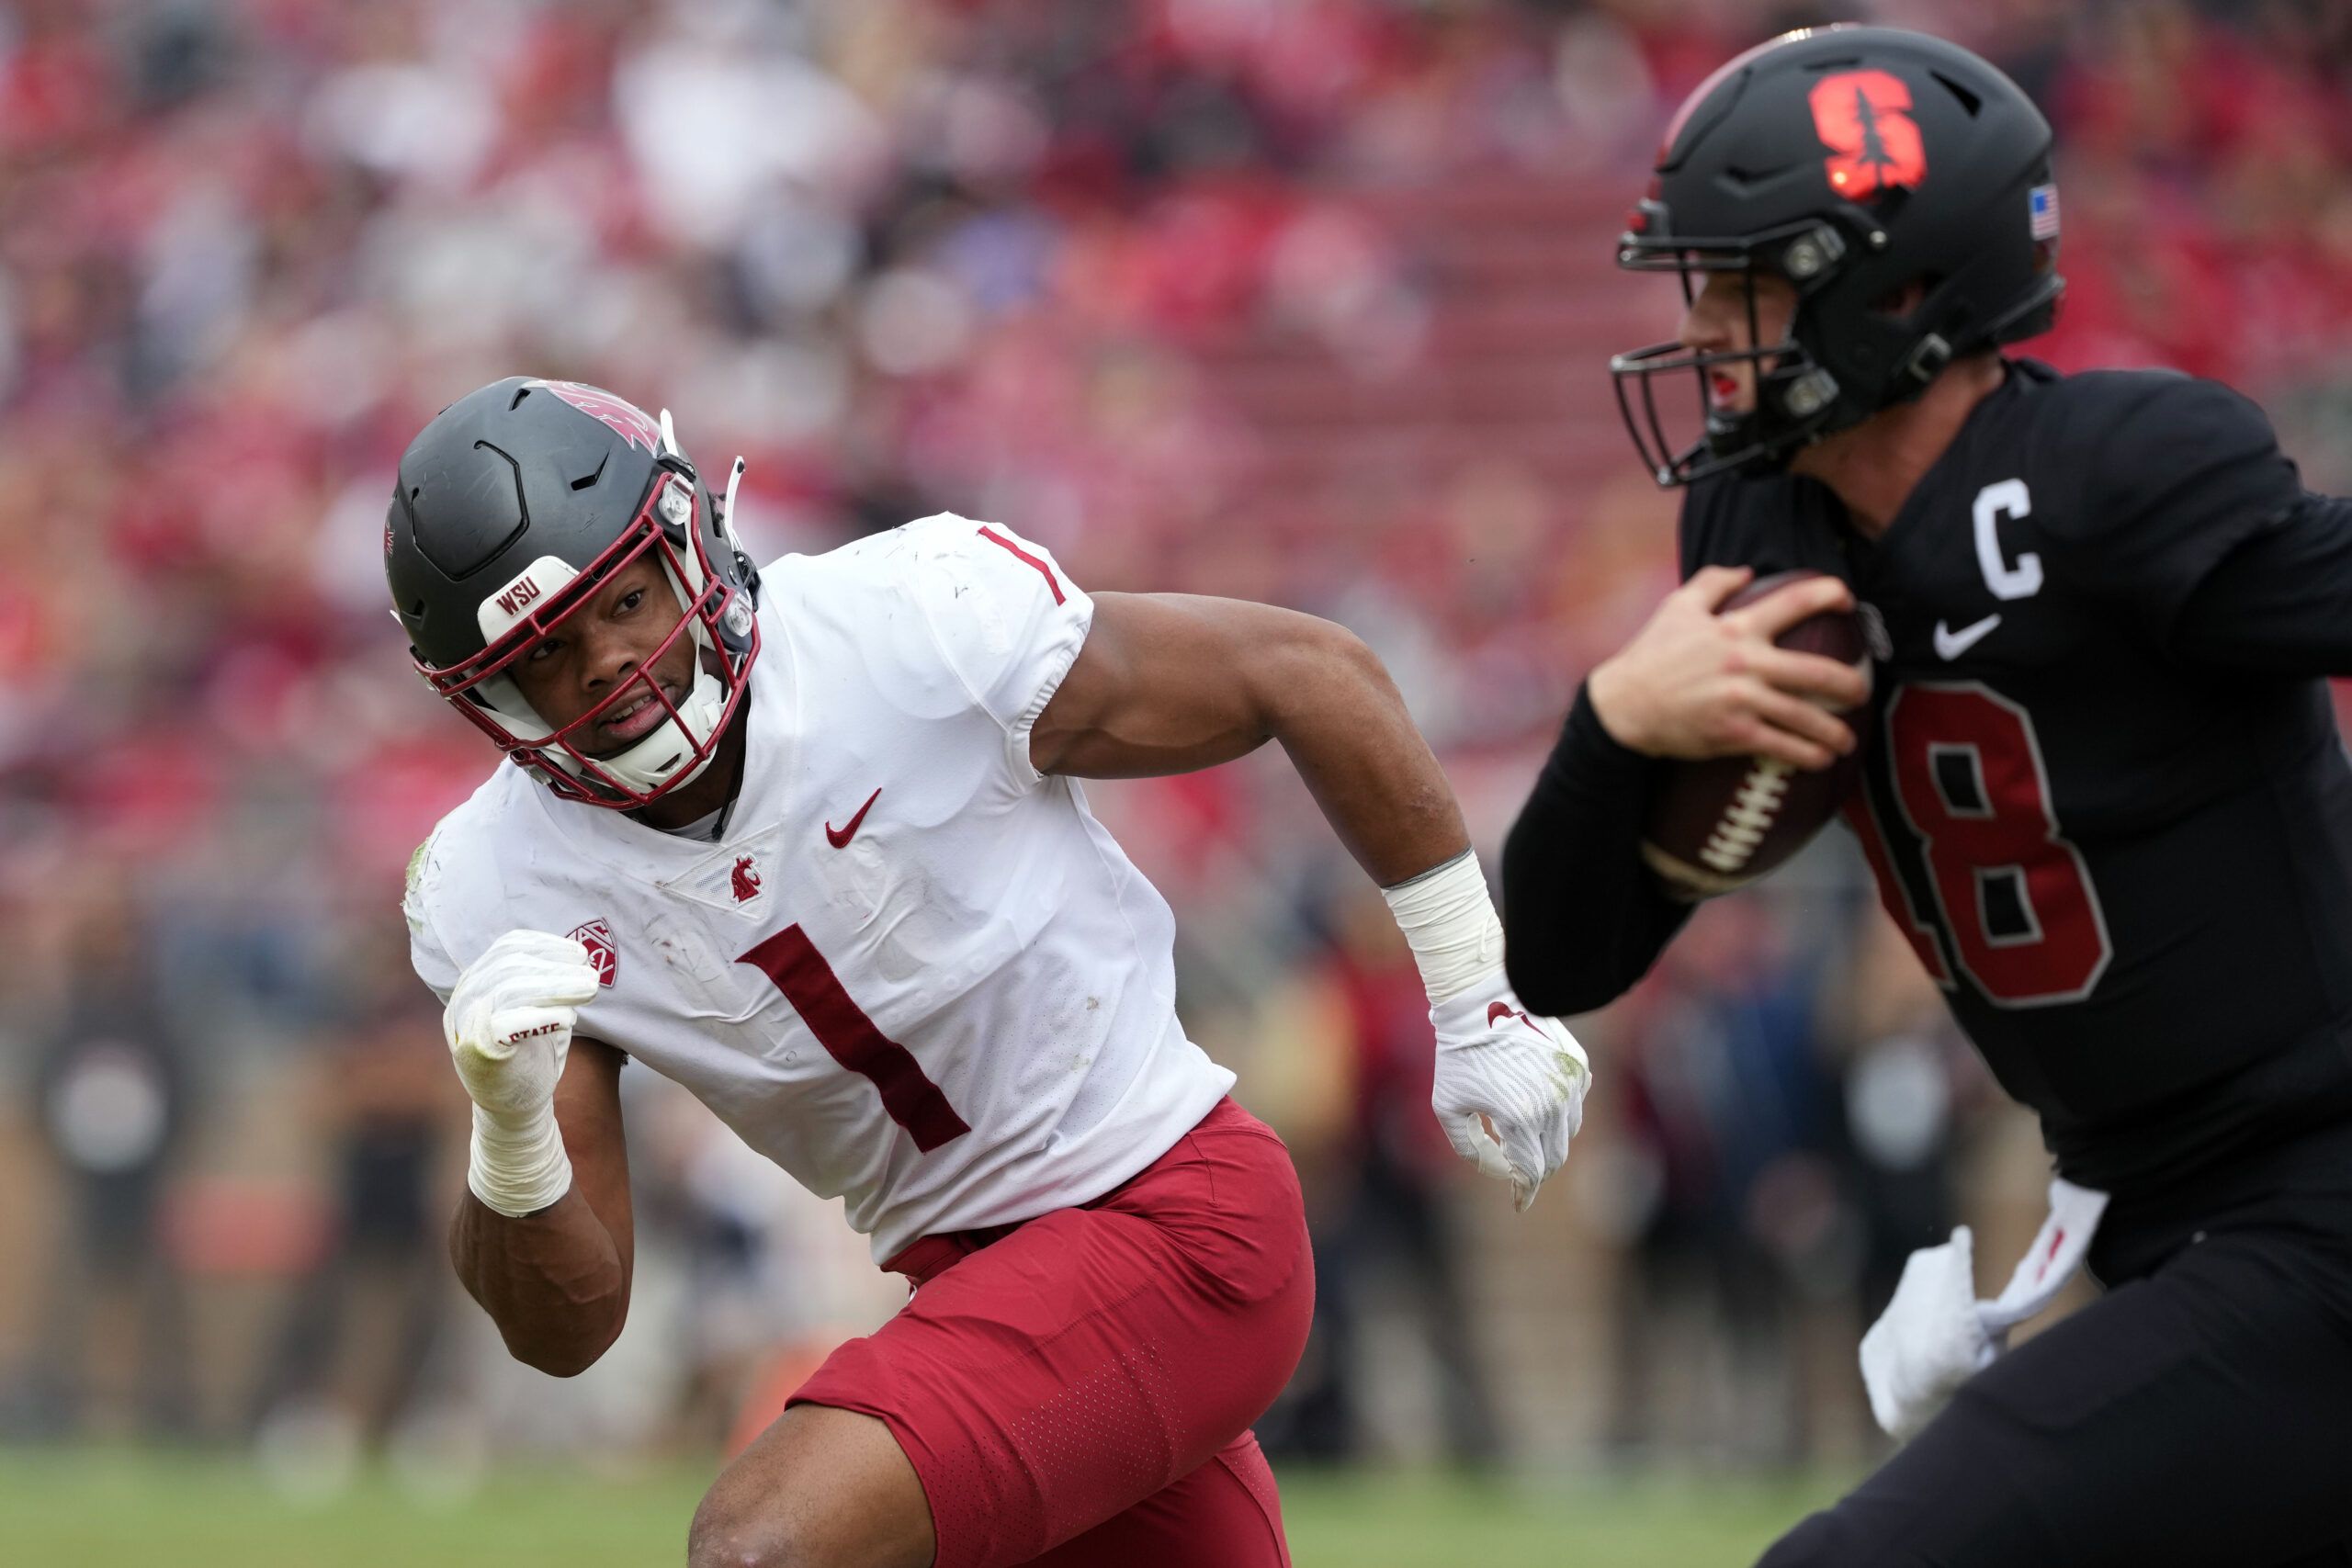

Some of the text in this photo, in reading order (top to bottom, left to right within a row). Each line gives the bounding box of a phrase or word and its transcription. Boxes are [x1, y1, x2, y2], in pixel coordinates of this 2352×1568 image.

[1808, 68, 1929, 206] S
[496, 576, 541, 616] WSU
[978, 525, 1067, 607] 1
[1972, 478, 2044, 601] C
[734, 922, 973, 1154] 1
